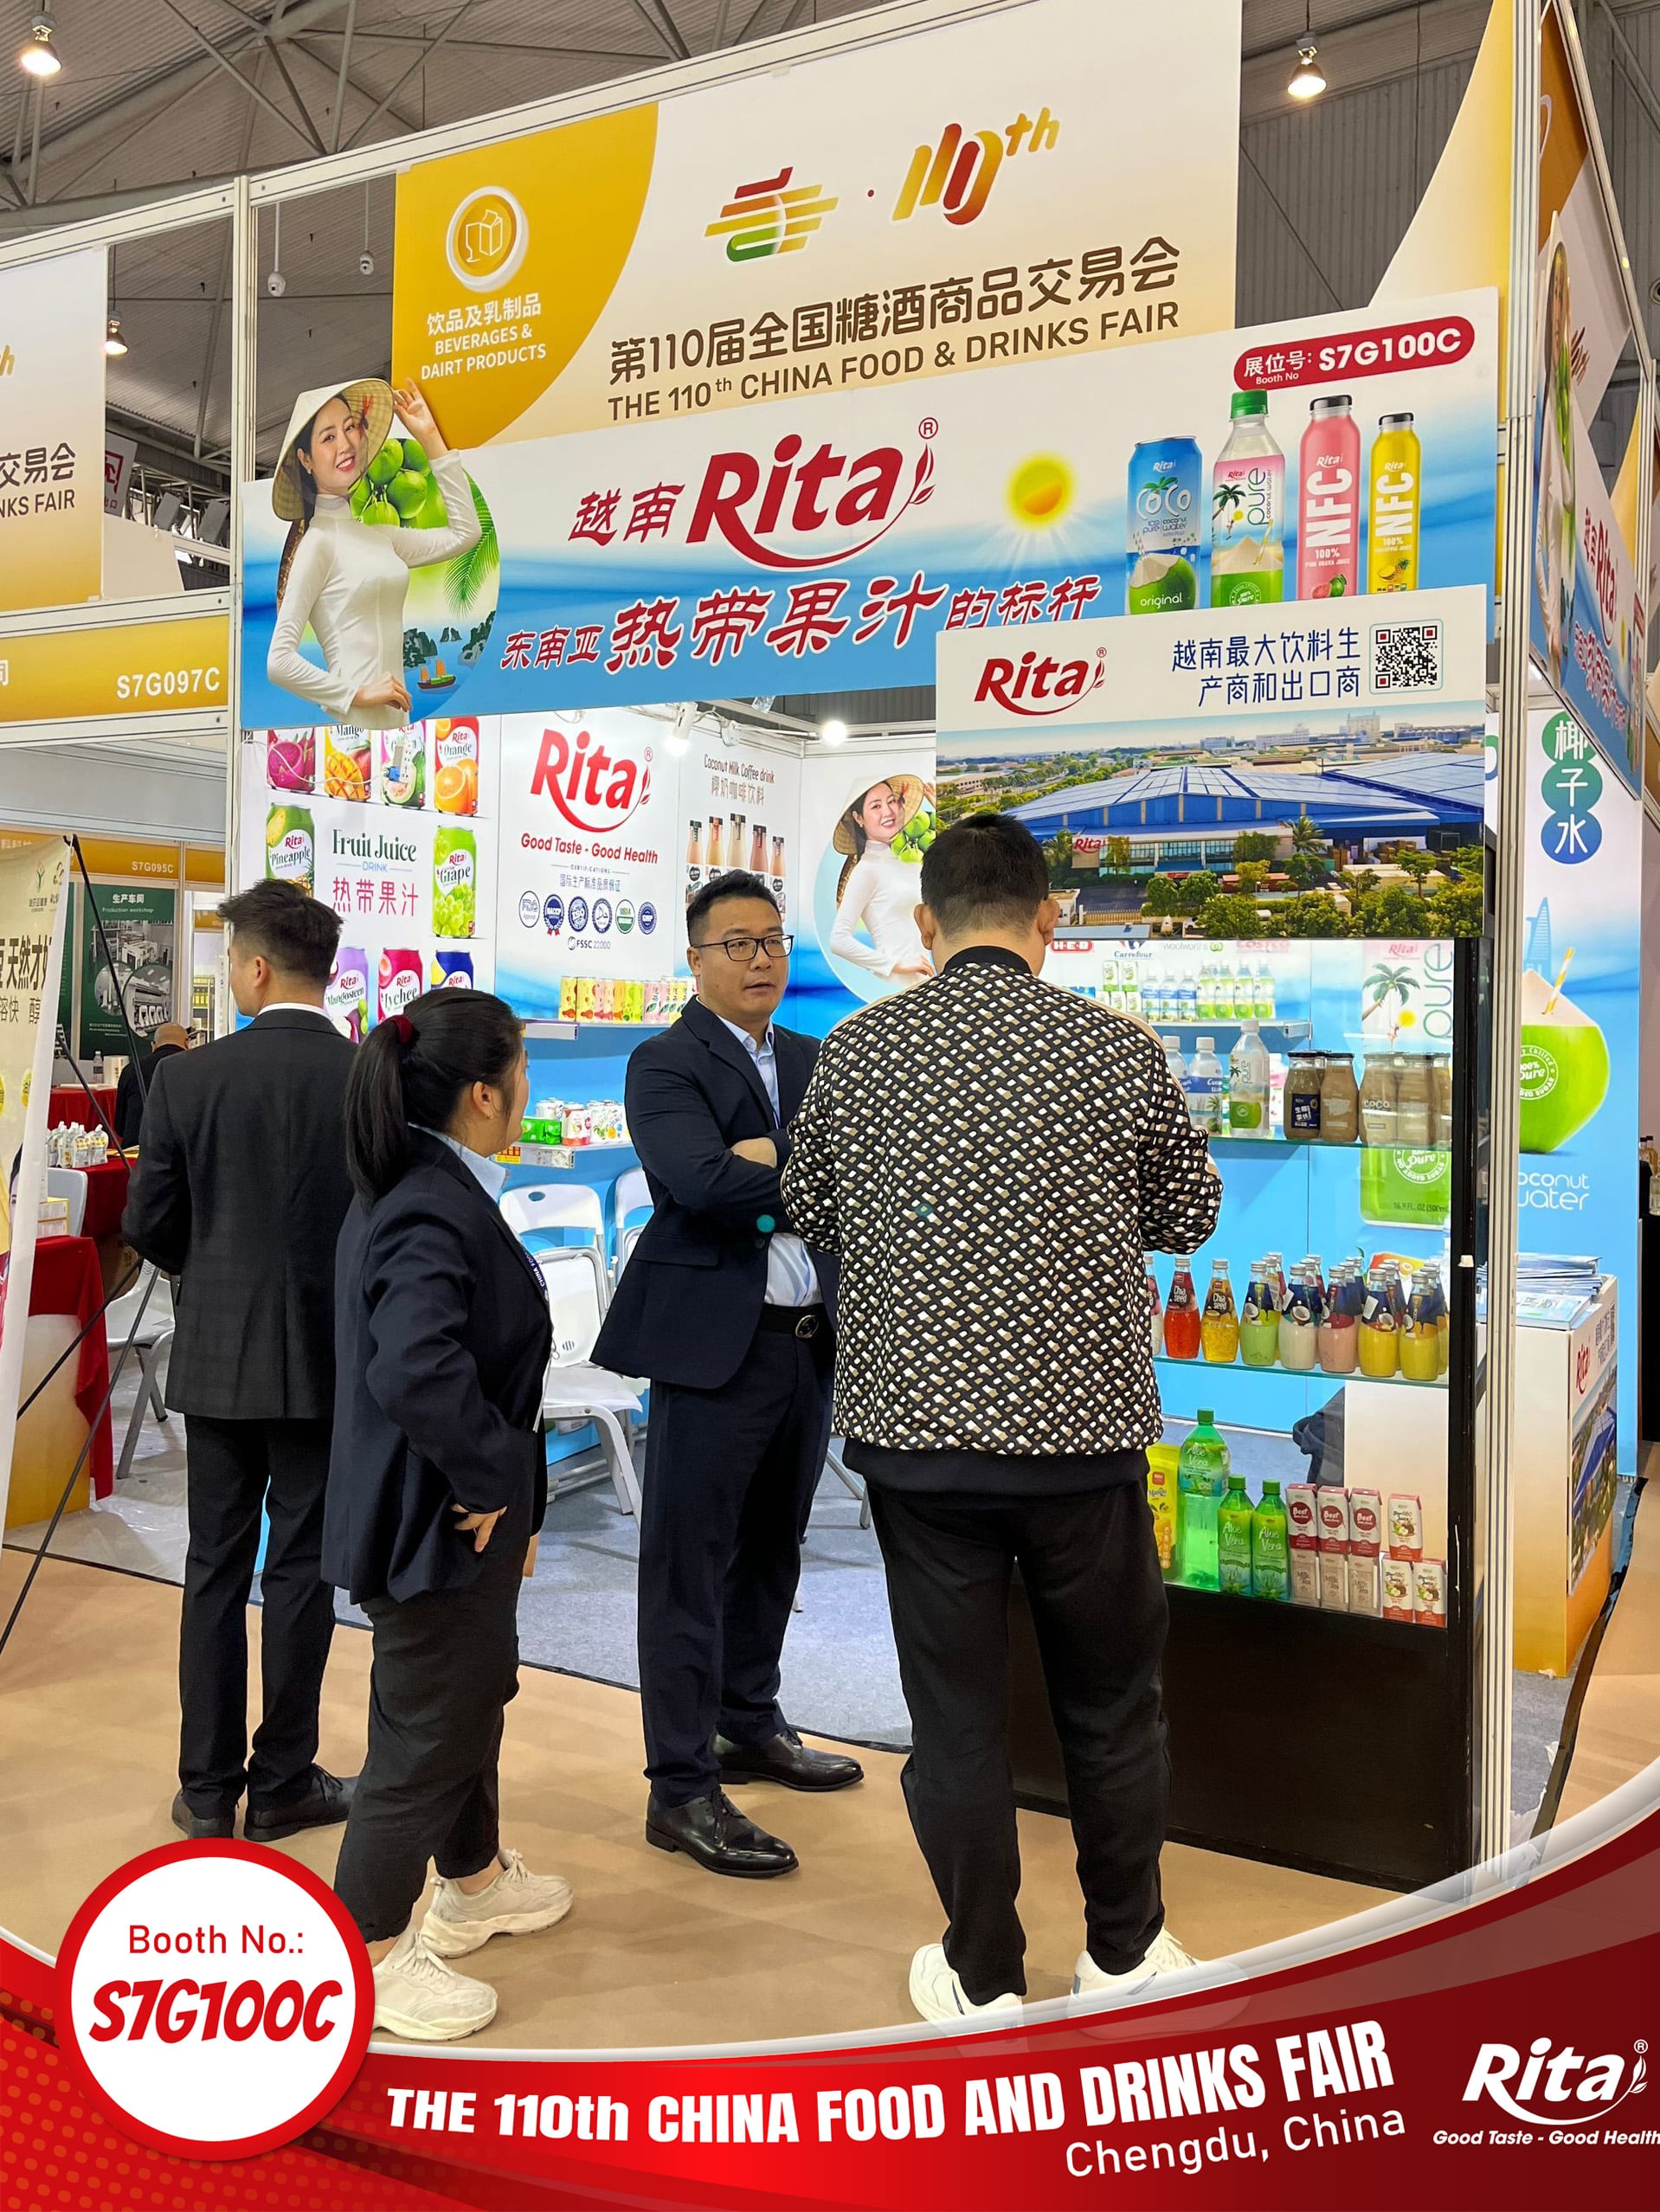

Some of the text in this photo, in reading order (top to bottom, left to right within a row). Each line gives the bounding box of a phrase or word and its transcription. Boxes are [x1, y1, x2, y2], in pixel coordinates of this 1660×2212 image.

[427, 293, 542, 337] 饮品及乳制品
[610, 236, 1180, 386] 第110届全国糖酒商品交易会
[434, 324, 532, 356] BEVERAGES &
[1319, 328, 1462, 371] S7G100C
[421, 344, 546, 380] DAIRT PRODUCTS
[608, 301, 1179, 421] THE 110th CHINA FOOD & DRINKS FAIR
[1256, 372, 1299, 385] Booth No
[1152, 460, 1174, 472] Rita
[1316, 455, 1340, 468] Rita
[1384, 461, 1404, 473] Rita
[35, 489, 75, 514] FAIR
[567, 433, 907, 569] 越南 Rita
[1247, 468, 1266, 526] pure
[1306, 468, 1353, 548] NFC
[1374, 472, 1414, 537] NFC
[1383, 537, 1404, 546] 100%
[1315, 548, 1340, 559] 100%
[1140, 593, 1182, 609] original
[500, 571, 1101, 674] 东南亚热带果汁的标杆
[1171, 627, 1361, 673] 越南最大饮料生
[116, 666, 221, 699] S7G097C
[975, 651, 1087, 716] Rita
[1198, 666, 1361, 707] 产商和出口商
[452, 731, 468, 743] Rita
[705, 754, 775, 784] Coconut Milk Coffee drink
[530, 729, 638, 833] Rita
[285, 835, 303, 849] Rita
[333, 829, 417, 862] Fruit Juice
[521, 833, 552, 851] Good
[555, 837, 582, 855] Taste
[592, 843, 621, 859] Good
[624, 847, 658, 864] Health
[1074, 838, 1102, 853] Rita
[270, 846, 311, 866] Pineapple
[448, 853, 466, 866] Rita
[132, 860, 174, 873] S7G095C
[363, 861, 388, 872] DRINK
[440, 866, 471, 884] Grape
[112, 894, 145, 904] 生产车间
[332, 877, 419, 916] 热带果汁
[576, 940, 592, 949] FSSC
[1163, 941, 1208, 950] woolworths
[1114, 950, 1152, 959] Carrefour
[340, 975, 357, 989] Rita
[396, 975, 412, 987] Rita
[1423, 942, 1453, 1038] pure
[1519, 1172, 1590, 1189] oconut
[1173, 1285, 1186, 1296] Chia
[1213, 1292, 1226, 1302] Chia
[1174, 1294, 1187, 1303] seed
[1213, 1301, 1227, 1310] seed
[1186, 1443, 1206, 1456] Aloe
[1188, 1454, 1208, 1467] Vera
[1293, 1507, 1308, 1515] Beef
[1323, 1510, 1339, 1520] Beef
[1357, 1513, 1373, 1521] Beef
[1223, 1521, 1241, 1534] Aloe
[1258, 1527, 1280, 1539] Aloe
[1225, 1534, 1245, 1546] Vera
[1261, 1539, 1283, 1551] Vera
